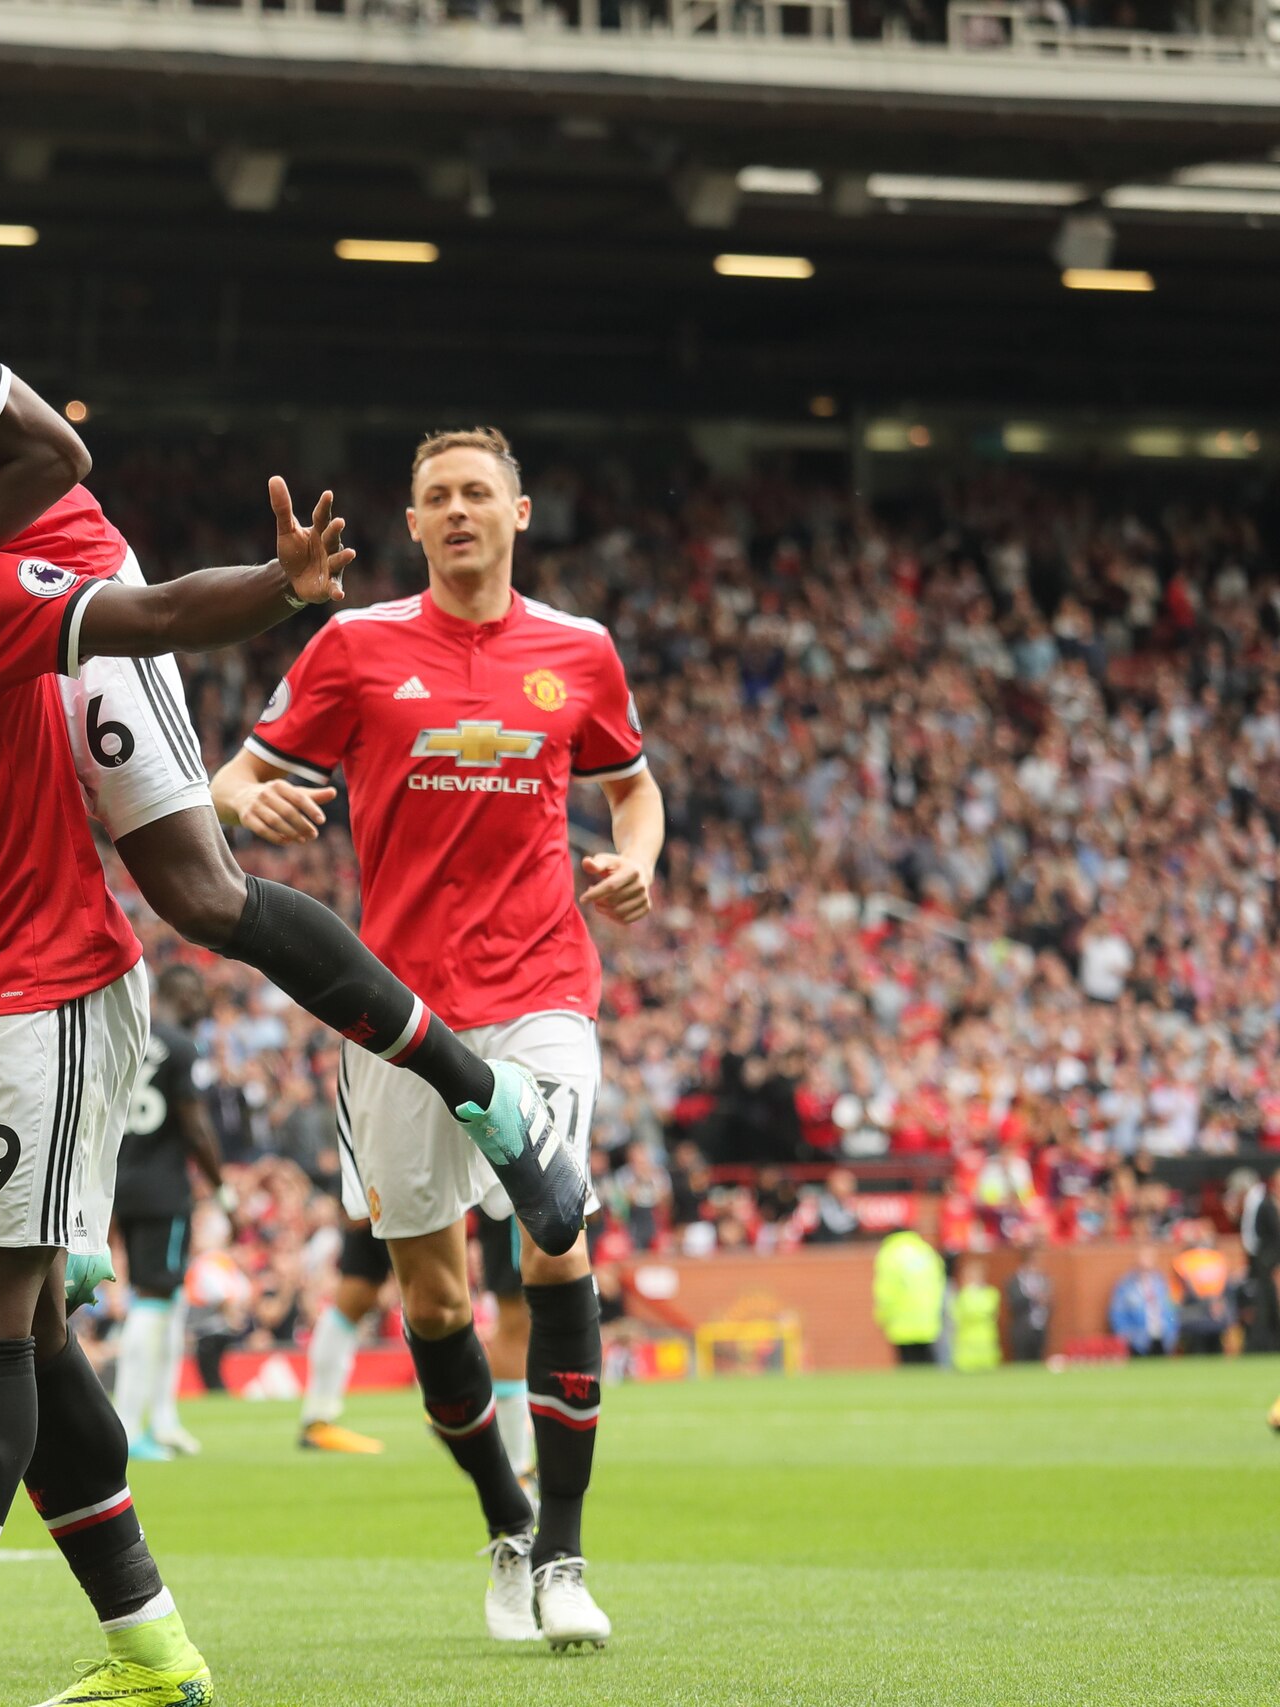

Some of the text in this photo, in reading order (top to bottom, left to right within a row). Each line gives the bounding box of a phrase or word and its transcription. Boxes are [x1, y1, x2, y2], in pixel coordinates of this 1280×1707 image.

[86, 694, 136, 769] 6
[407, 773, 542, 795] CHEVROLET
[122, 1062, 168, 1136] 6
